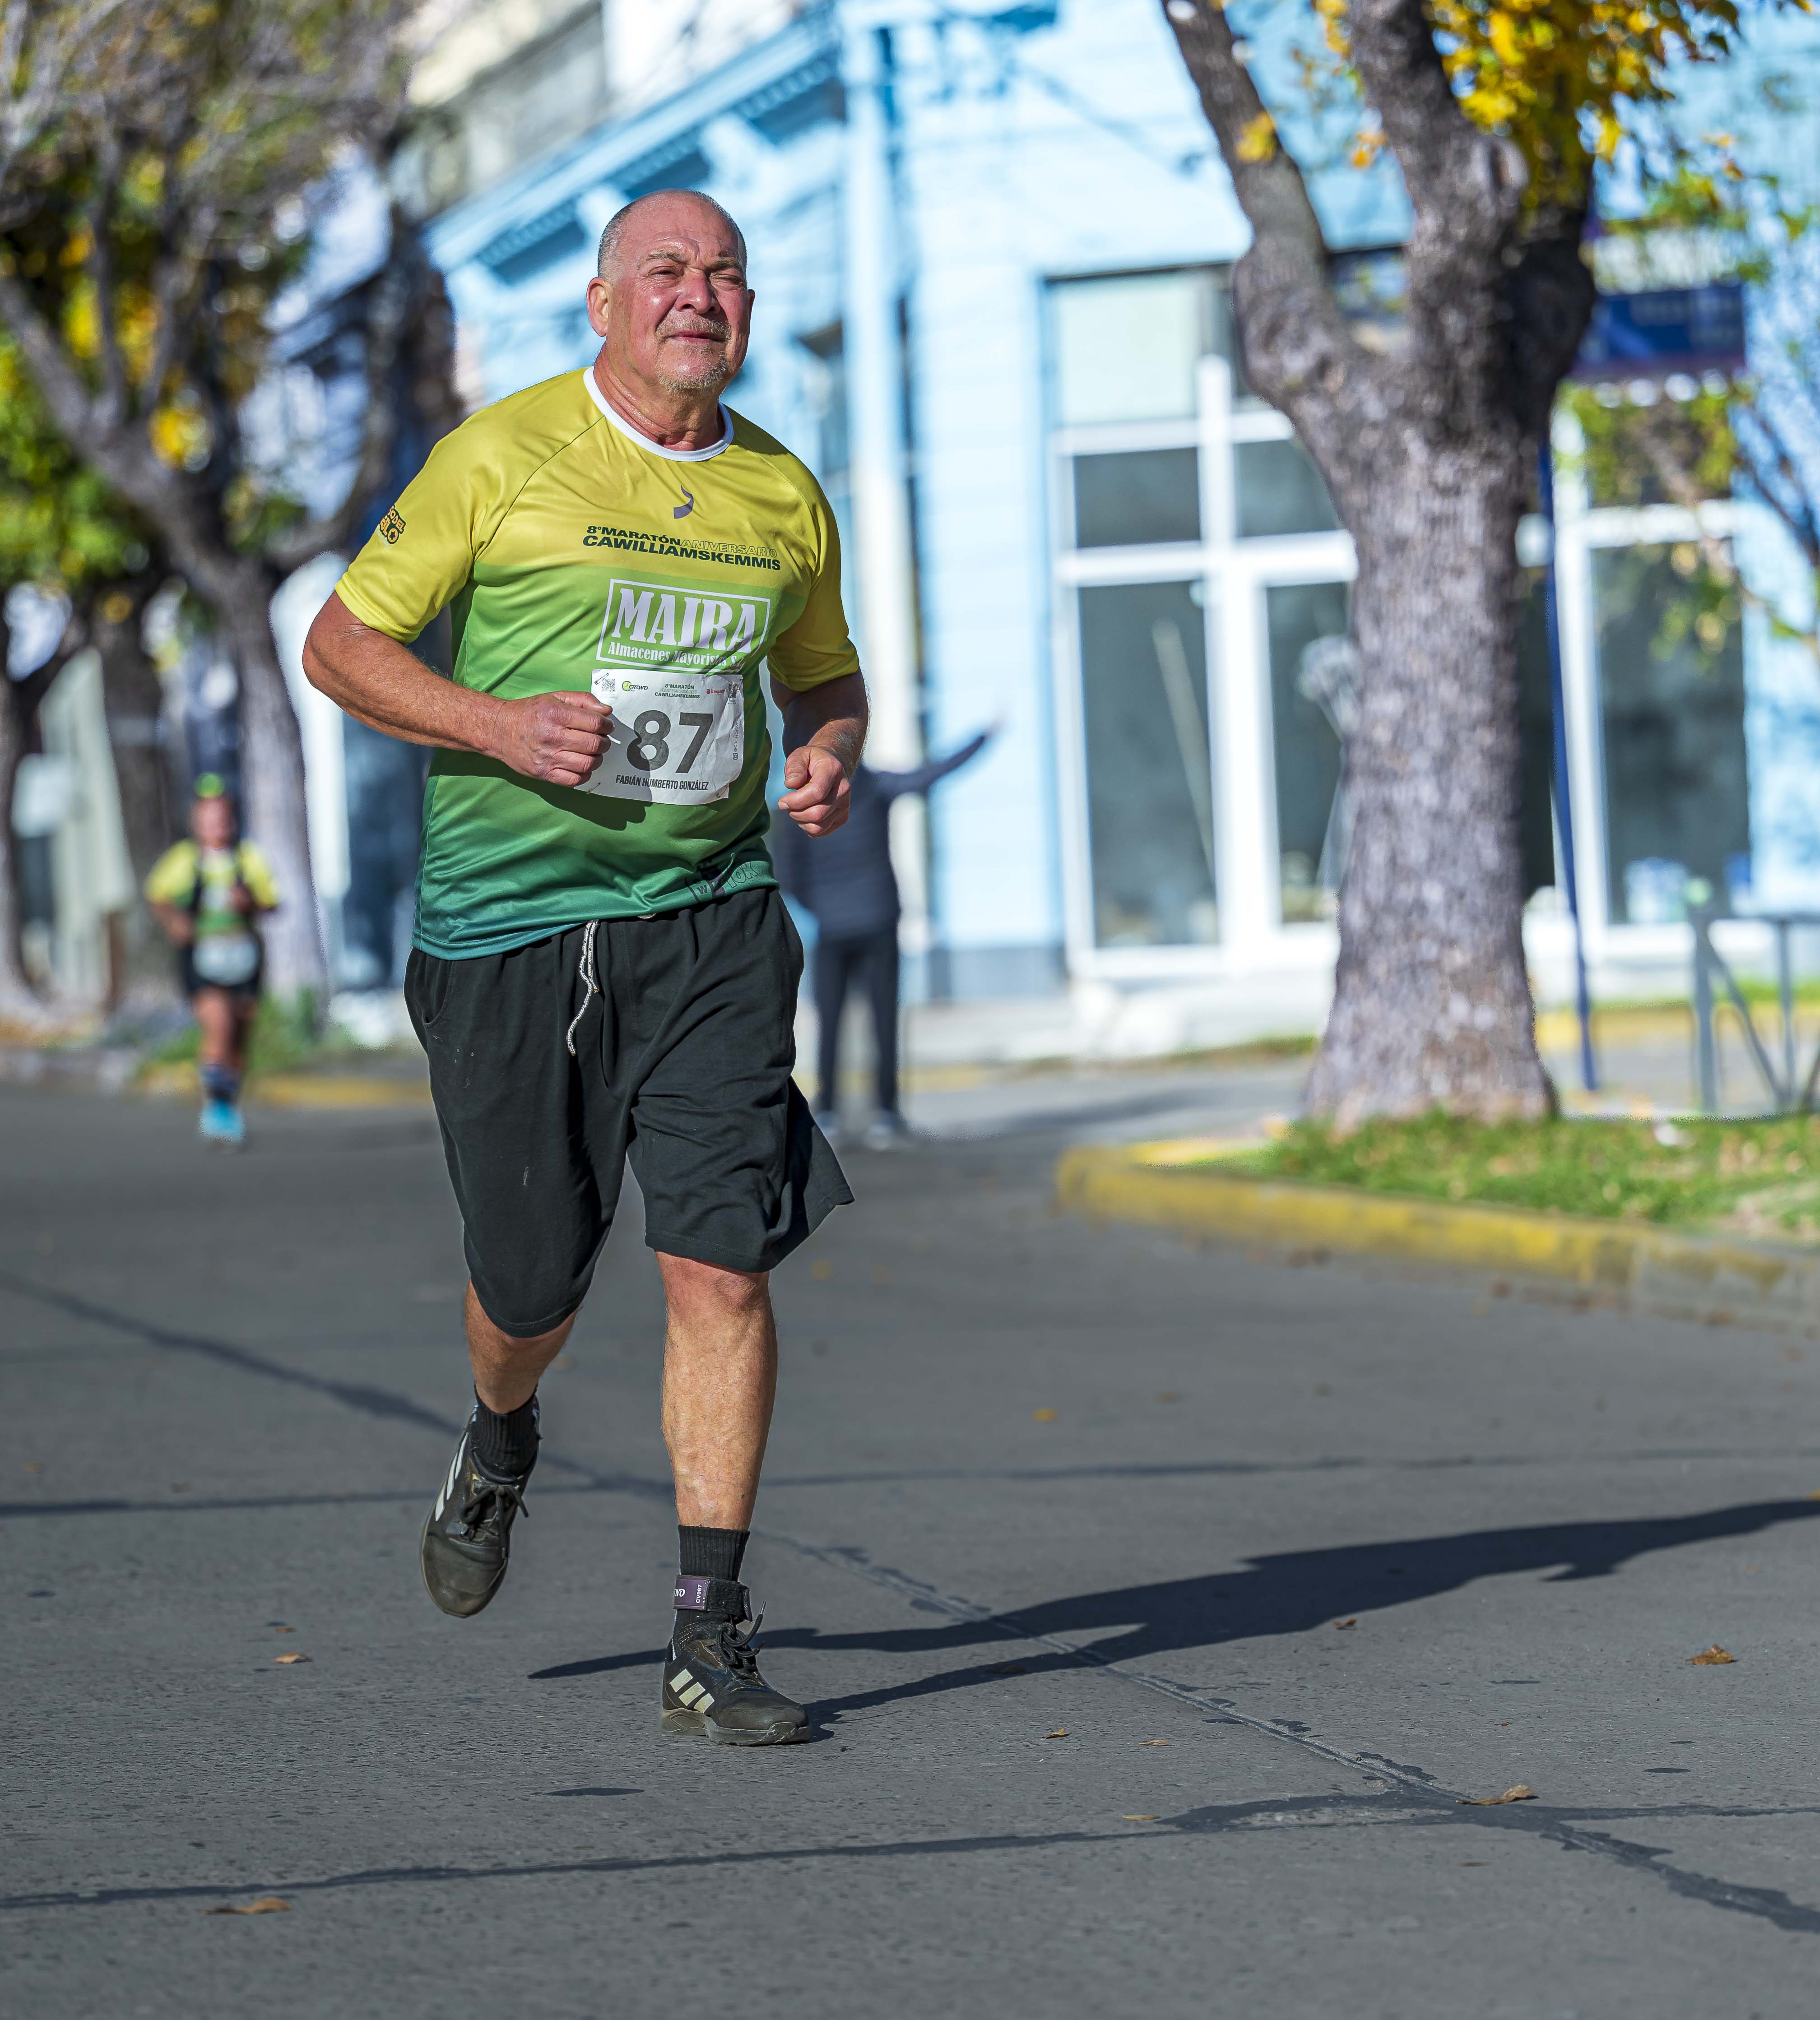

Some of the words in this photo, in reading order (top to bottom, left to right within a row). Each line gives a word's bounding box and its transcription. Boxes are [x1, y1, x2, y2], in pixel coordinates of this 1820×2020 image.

[583, 535, 780, 570] CAWILLIAMSKEMMIS
[681, 539, 777, 558] ANIVERSARIO
[611, 588, 755, 653] MAIRA
[607, 642, 670, 662] Almacenes
[626, 710, 713, 773] 87
[615, 774, 641, 786] FABIÁN
[642, 778, 678, 789] HUMBERTO
[679, 780, 709, 790] GONZÁLEZ
